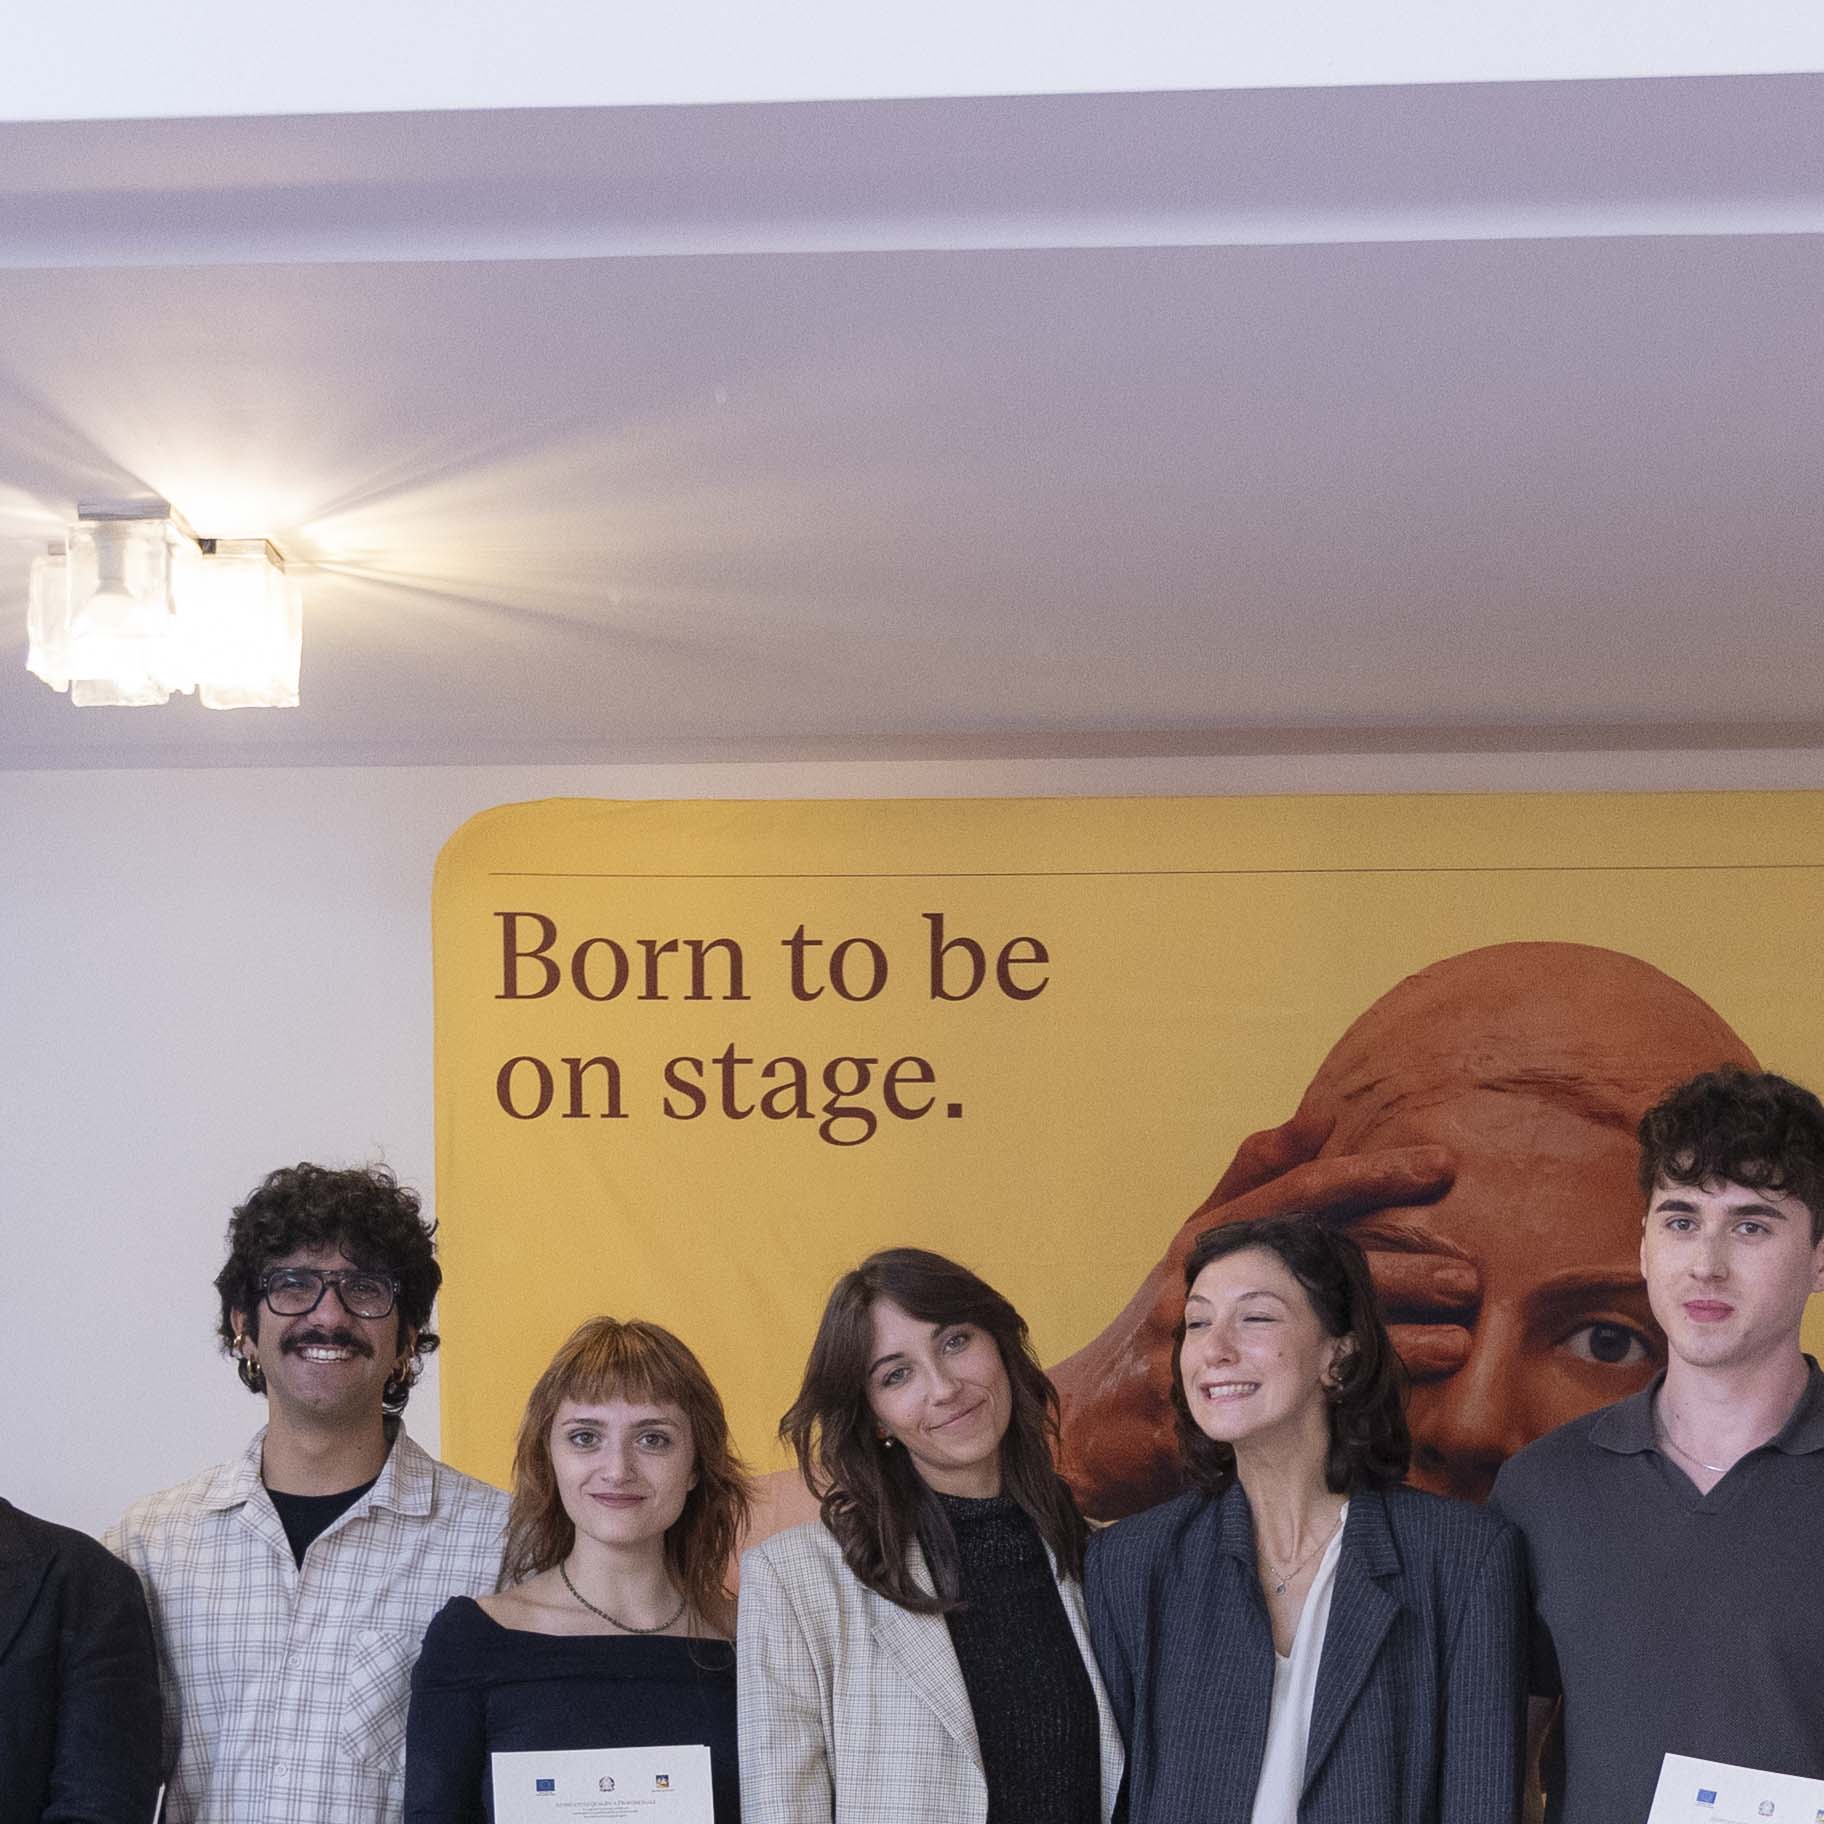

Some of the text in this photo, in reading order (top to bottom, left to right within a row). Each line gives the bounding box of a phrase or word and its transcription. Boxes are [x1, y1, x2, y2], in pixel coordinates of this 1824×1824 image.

[493, 911, 1050, 1002] Born to be
[496, 1042, 964, 1147] on stage.
